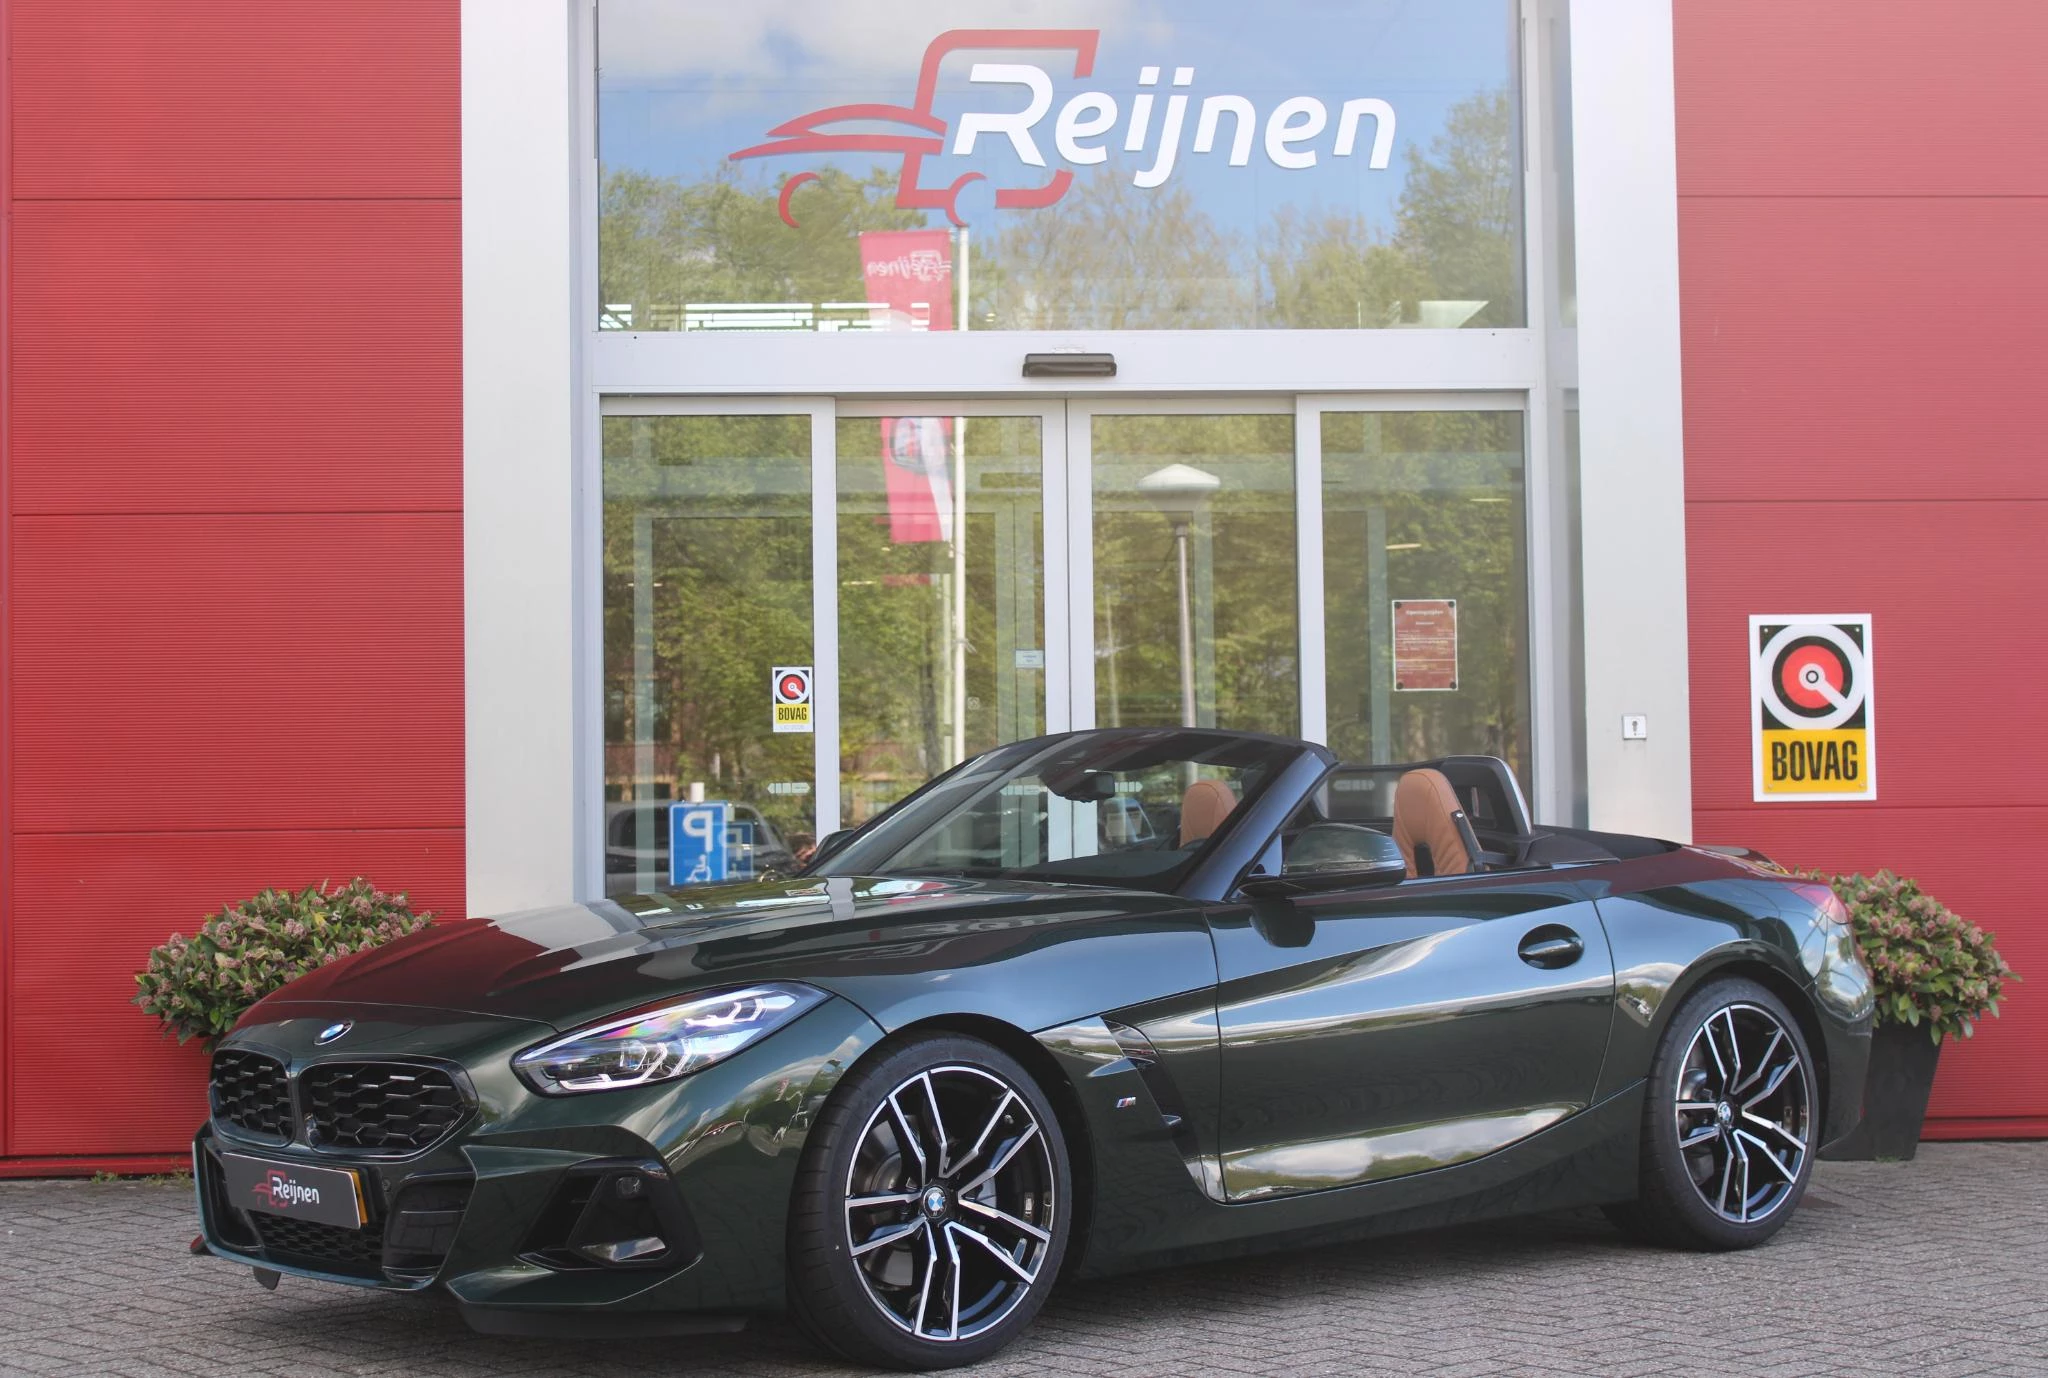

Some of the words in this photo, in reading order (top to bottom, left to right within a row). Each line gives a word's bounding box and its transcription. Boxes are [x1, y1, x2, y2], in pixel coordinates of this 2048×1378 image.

[952, 63, 1396, 188] Reijnen
[778, 707, 807, 721] BOVAG
[1771, 740, 1858, 781] BOVAG
[273, 1177, 319, 1205] Reijnen
